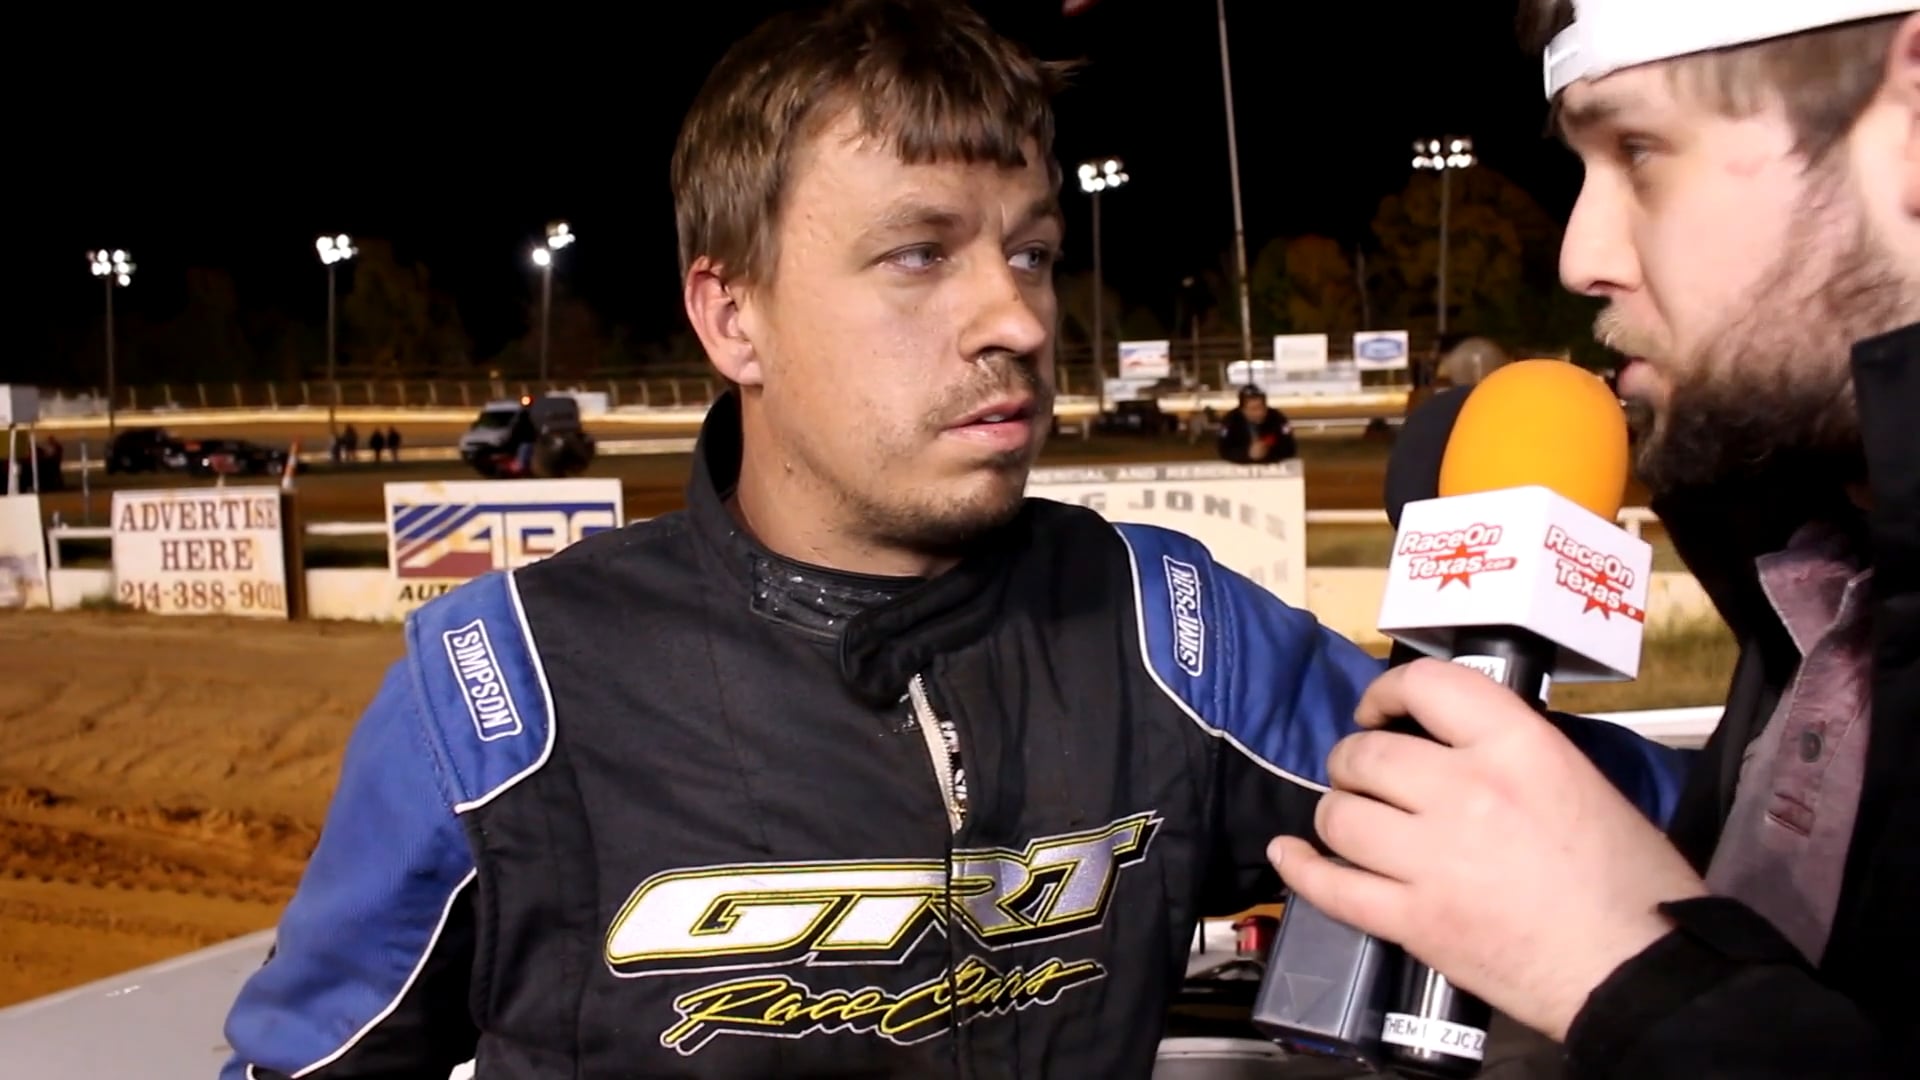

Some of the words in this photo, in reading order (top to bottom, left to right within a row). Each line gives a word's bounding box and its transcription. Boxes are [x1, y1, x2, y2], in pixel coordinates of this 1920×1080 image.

[119, 497, 278, 532] ADVERTISE
[1128, 488, 1287, 542] JONES
[1398, 522, 1503, 556] RaceOn
[160, 538, 253, 572] HERE
[1544, 525, 1636, 590] RaceOn
[397, 582, 458, 603] AUT
[1170, 565, 1199, 666] SIMPSON
[453, 630, 513, 729] SIMPSON
[604, 811, 1162, 976] GRT
[660, 977, 892, 1050] Race
[880, 956, 1106, 1039] Cars
